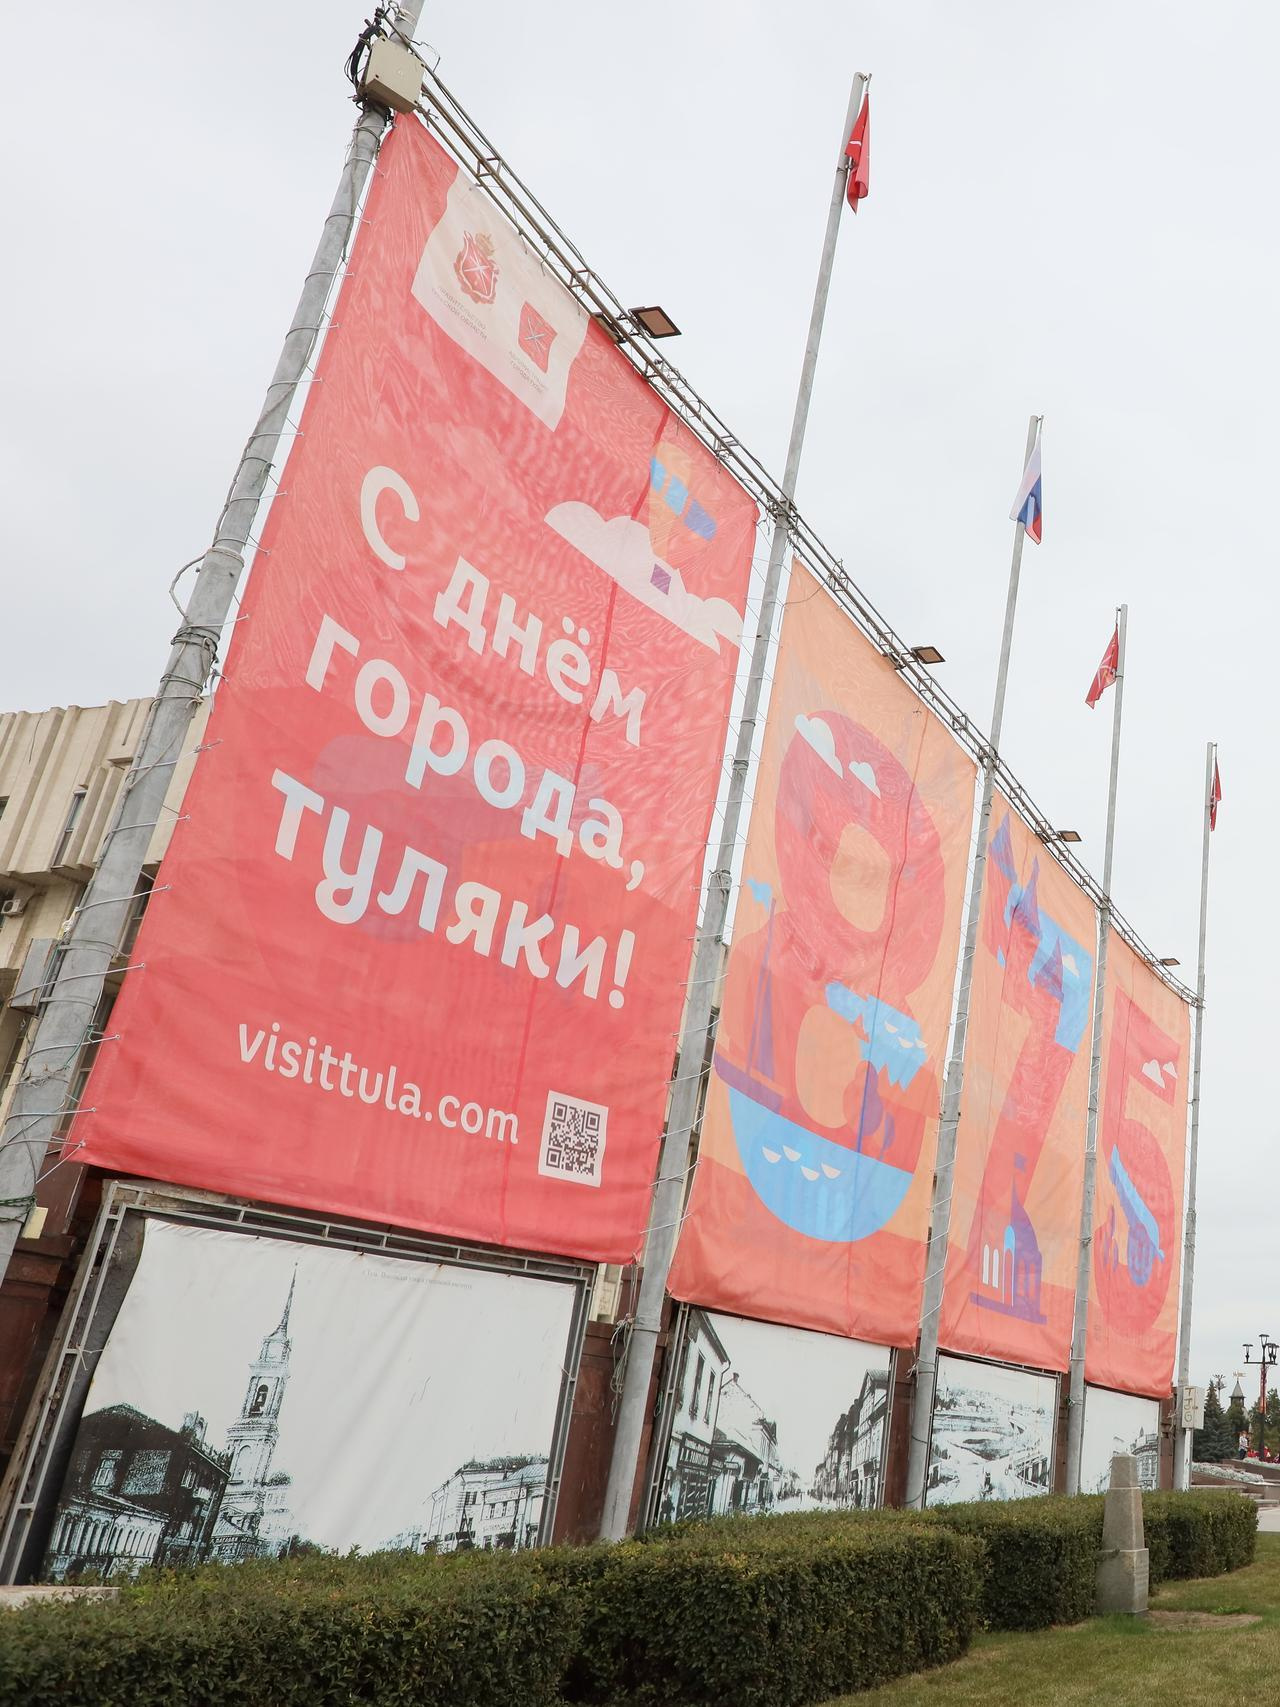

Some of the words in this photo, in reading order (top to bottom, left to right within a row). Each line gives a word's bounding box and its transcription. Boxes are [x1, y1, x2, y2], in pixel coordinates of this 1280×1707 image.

[360, 465, 420, 571] С
[433, 556, 647, 746] днём
[305, 613, 645, 891] города,
[271, 768, 635, 1009] туляки!
[238, 1022, 520, 1145] visittula.com
